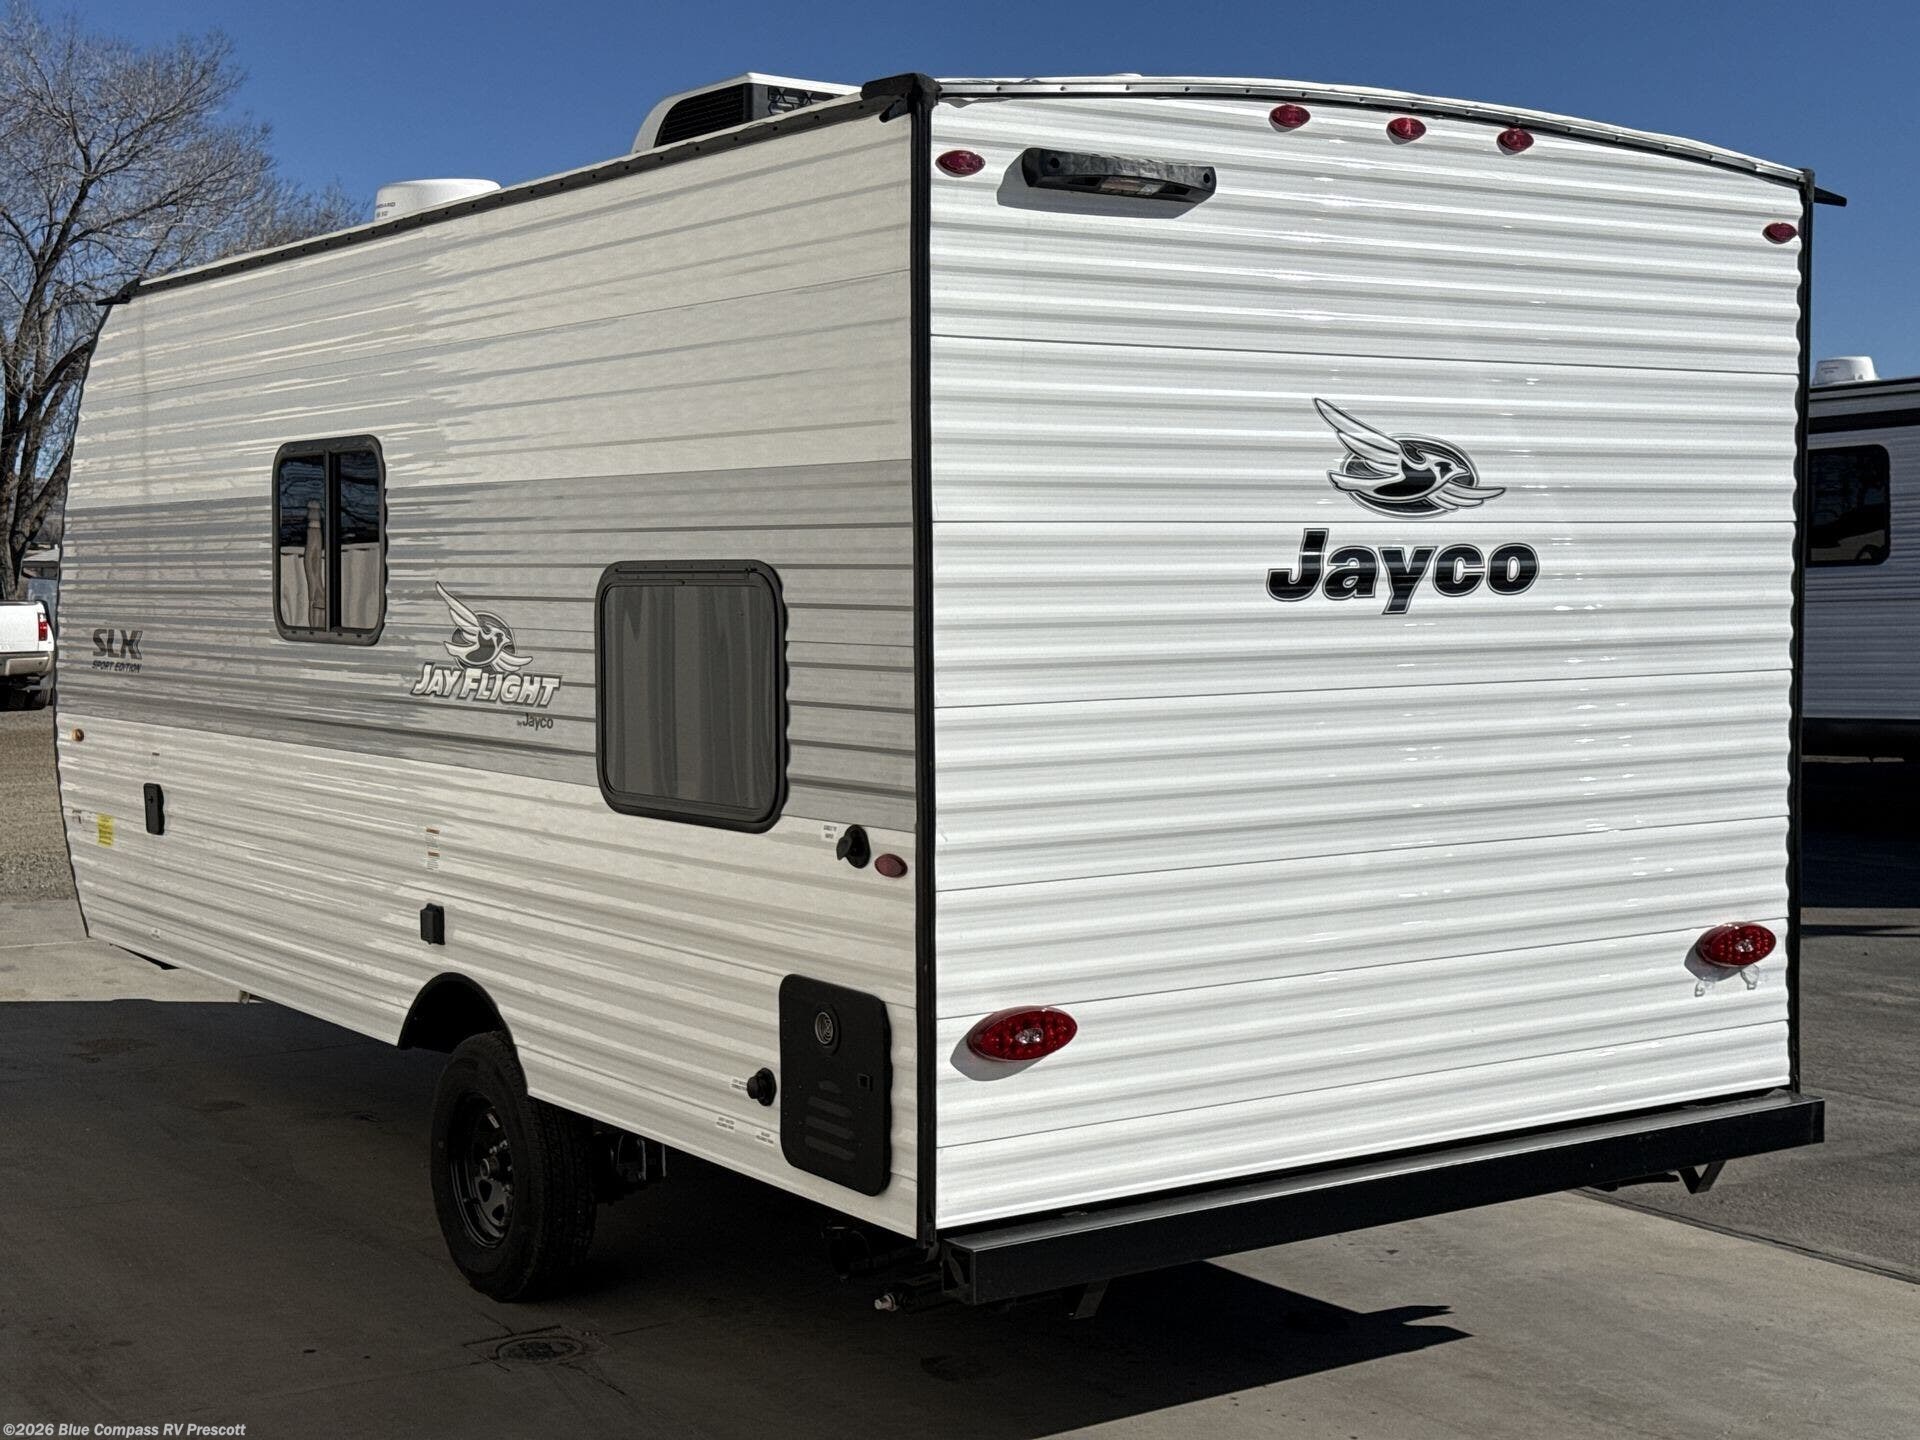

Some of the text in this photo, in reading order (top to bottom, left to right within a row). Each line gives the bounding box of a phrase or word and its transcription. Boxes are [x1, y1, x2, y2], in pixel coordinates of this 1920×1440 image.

[1266, 527, 1540, 615] Jayco
[92, 628, 143, 660] SLX
[92, 660, 143, 673] SPORT EDITION
[411, 662, 562, 708] JAY FLIGHT
[523, 712, 554, 731] Jayco
